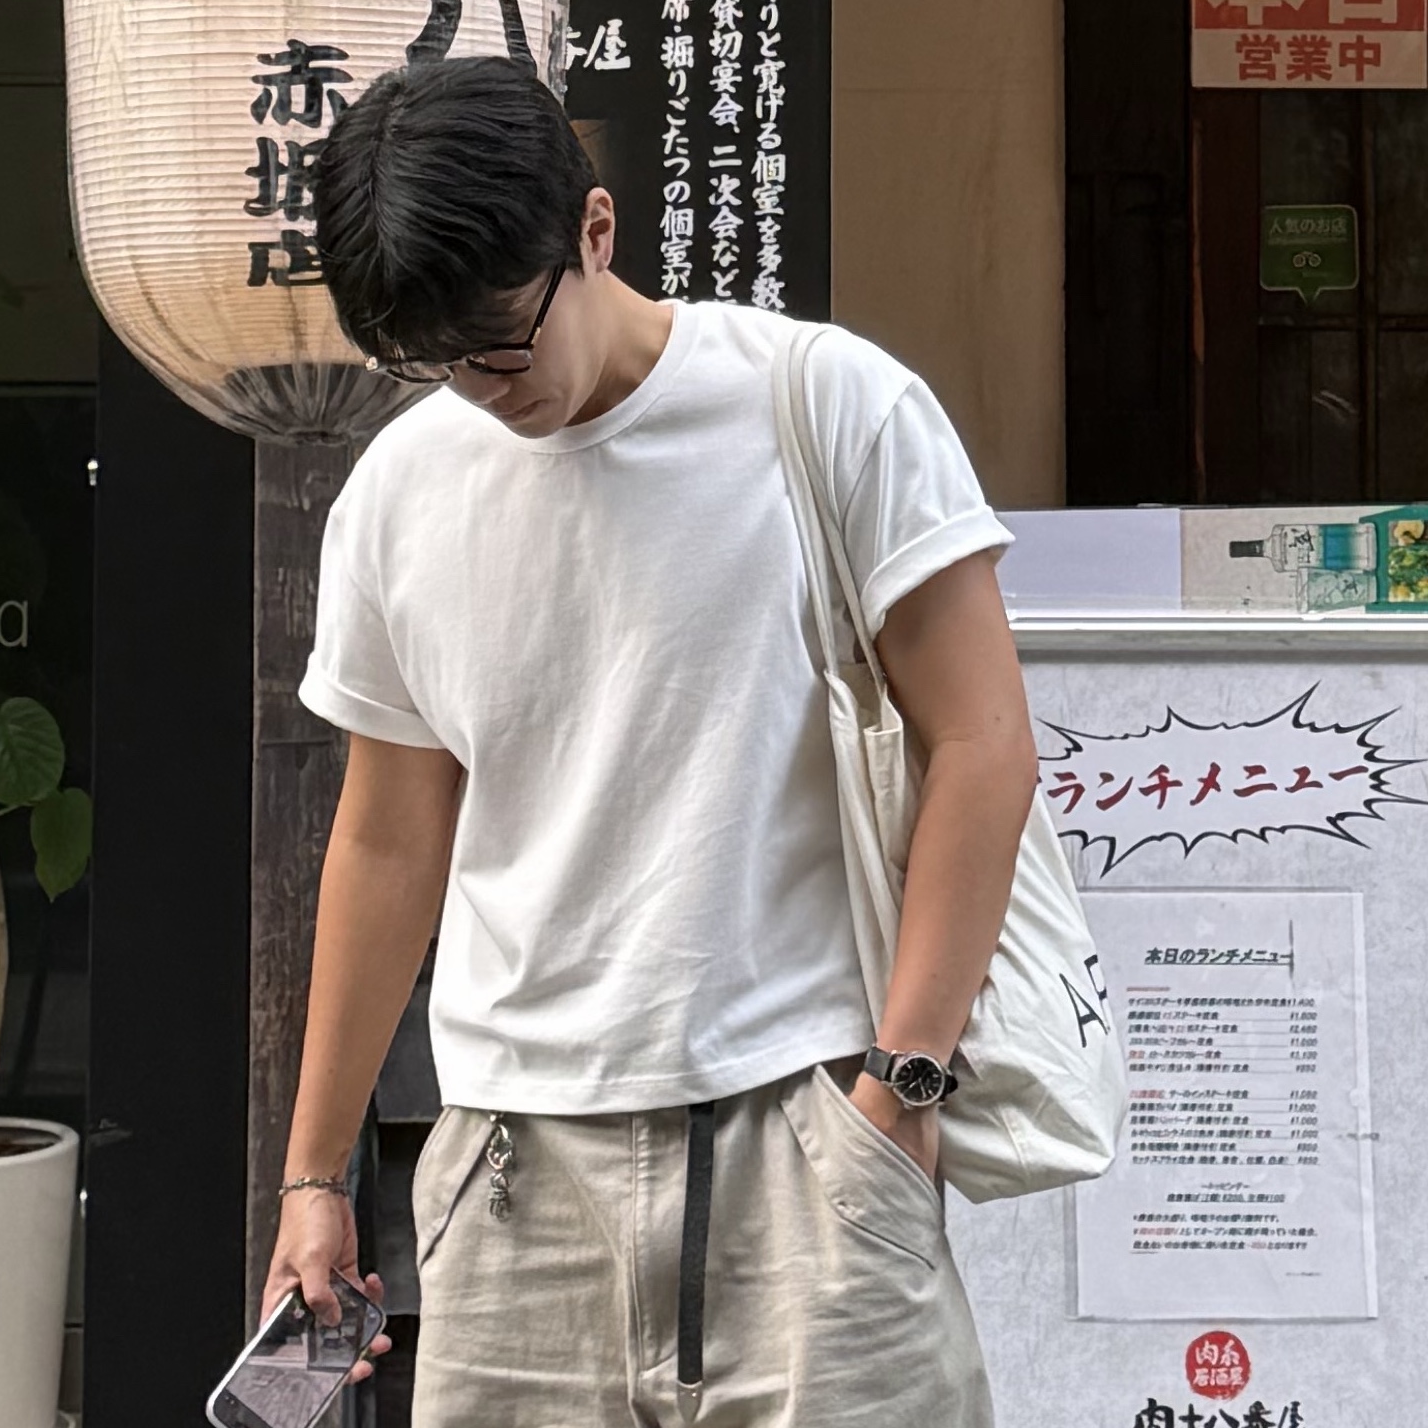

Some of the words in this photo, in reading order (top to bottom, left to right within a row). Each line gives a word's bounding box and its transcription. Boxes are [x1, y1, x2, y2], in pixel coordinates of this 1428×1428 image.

[1235, 34, 1382, 83] 営業中
[1037, 762, 1370, 814] ランチメニュー
[1145, 947, 1293, 965] 本日のランチメニュー
[1193, 1367, 1245, 1387] 居酒屋
